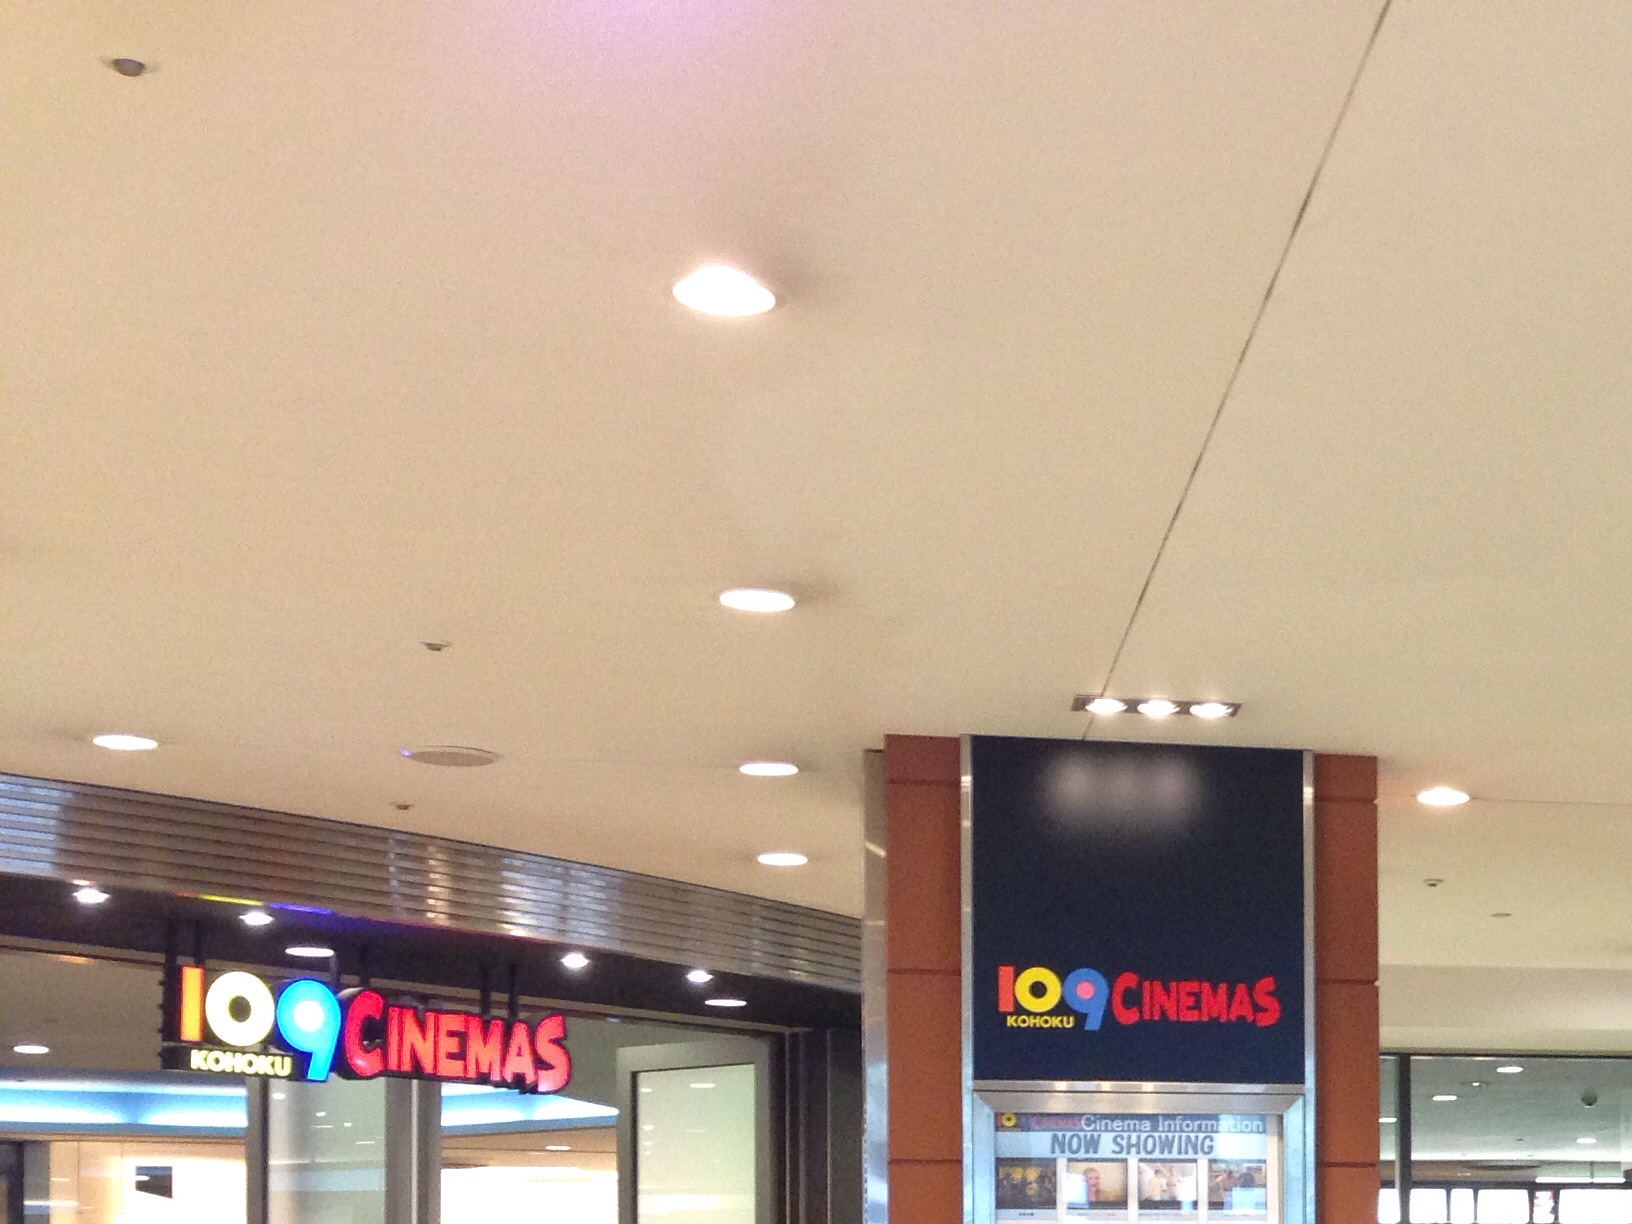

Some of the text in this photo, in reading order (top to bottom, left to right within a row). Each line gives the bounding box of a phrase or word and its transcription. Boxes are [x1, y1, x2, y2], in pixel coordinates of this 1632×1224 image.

[998, 965, 1281, 1030] 109 CINEMAS
[180, 965, 571, 1093] 109 CINEMAS
[1006, 1015, 1075, 1028] KOHOKU
[190, 1050, 292, 1076] KOHOKU
[1081, 1114, 1150, 1131] Cinema
[1159, 1114, 1263, 1132] Information
[1051, 1134, 1214, 1155] NOW SHOWING
